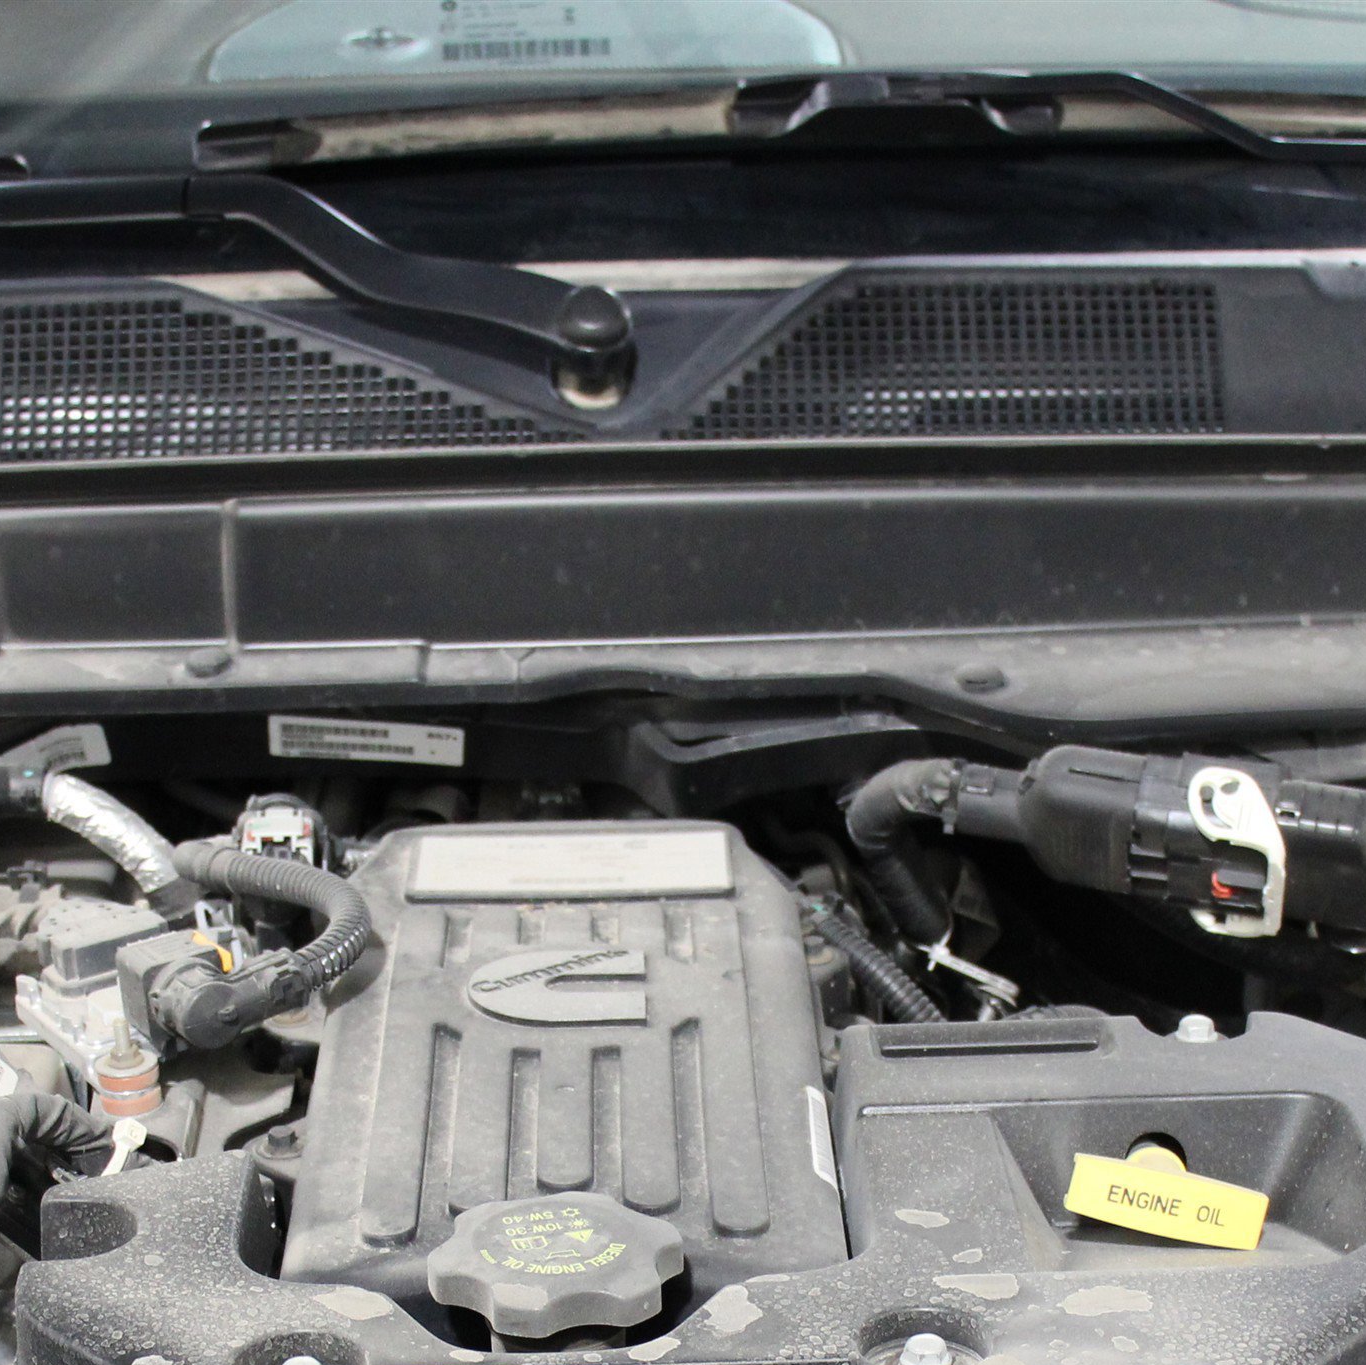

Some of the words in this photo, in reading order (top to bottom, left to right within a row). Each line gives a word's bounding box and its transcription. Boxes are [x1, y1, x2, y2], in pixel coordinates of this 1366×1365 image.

[471, 950, 629, 993] Cummins
[1107, 1184, 1182, 1217] ENGINE
[1196, 1204, 1225, 1227] OIL
[502, 1211, 554, 1224] 5W-40
[505, 1222, 563, 1236] 10W-30
[584, 1243, 627, 1267] DIESEL
[501, 1257, 524, 1269] OIL
[524, 1263, 586, 1275] ENGINE
